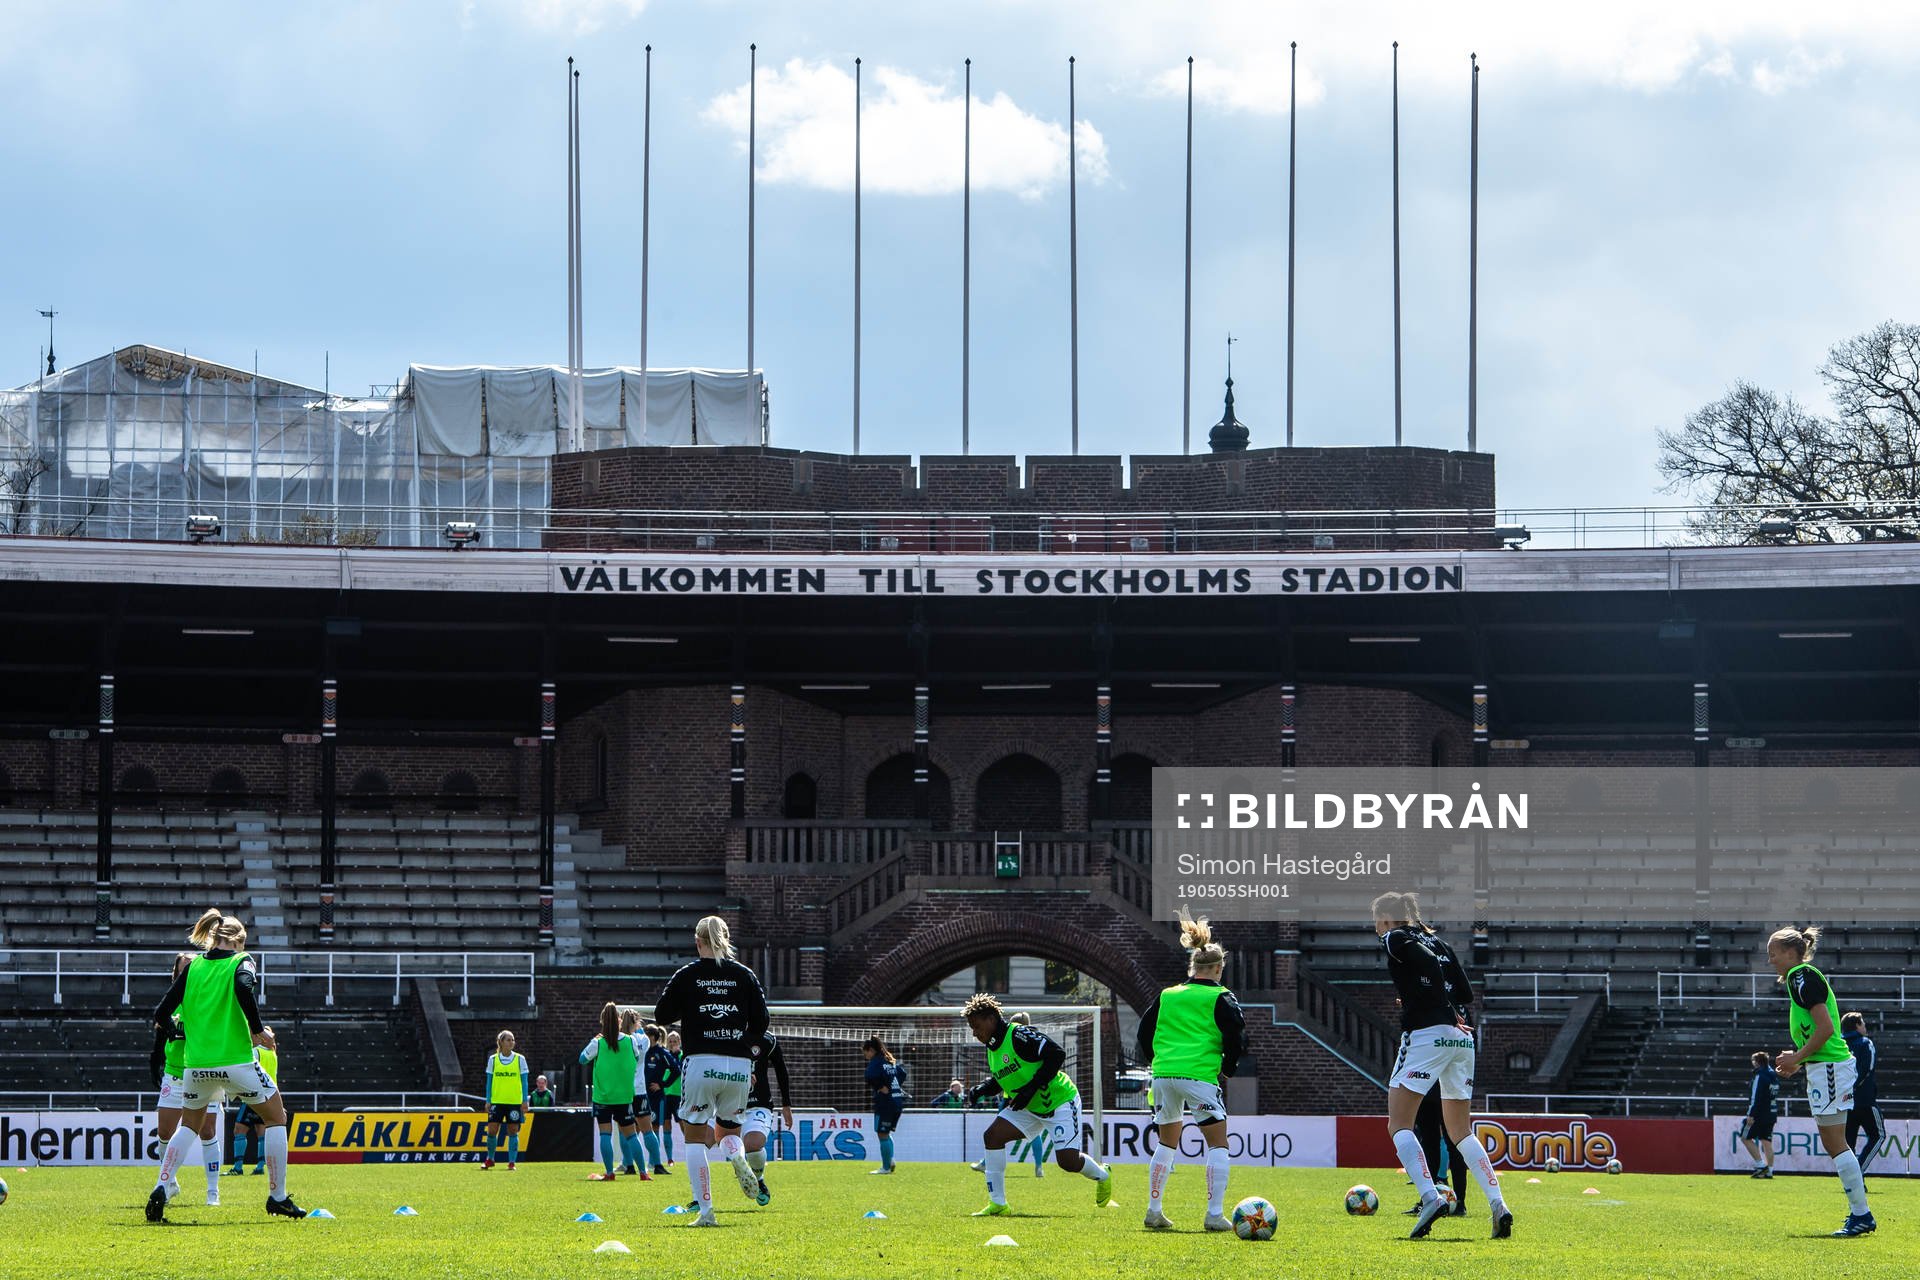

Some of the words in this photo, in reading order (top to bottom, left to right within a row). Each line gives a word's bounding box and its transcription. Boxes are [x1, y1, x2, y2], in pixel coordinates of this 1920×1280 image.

[560, 560, 826, 592] VÄLKOMMEN
[859, 568, 945, 593] TILL
[976, 568, 1251, 594] STOCKHOLMS
[1281, 566, 1463, 593] STADION
[696, 979, 737, 988] Sparbanken
[706, 987, 728, 995] Skåne
[699, 1004, 739, 1012] STARKA
[199, 1070, 230, 1079] STENA
[819, 1115, 863, 1129] JÄRN
[767, 1120, 867, 1161] nks
[1178, 1122, 1293, 1167] Goup
[1474, 1122, 1614, 1166] Dumle
[384, 1152, 483, 1162] WORKWEA
